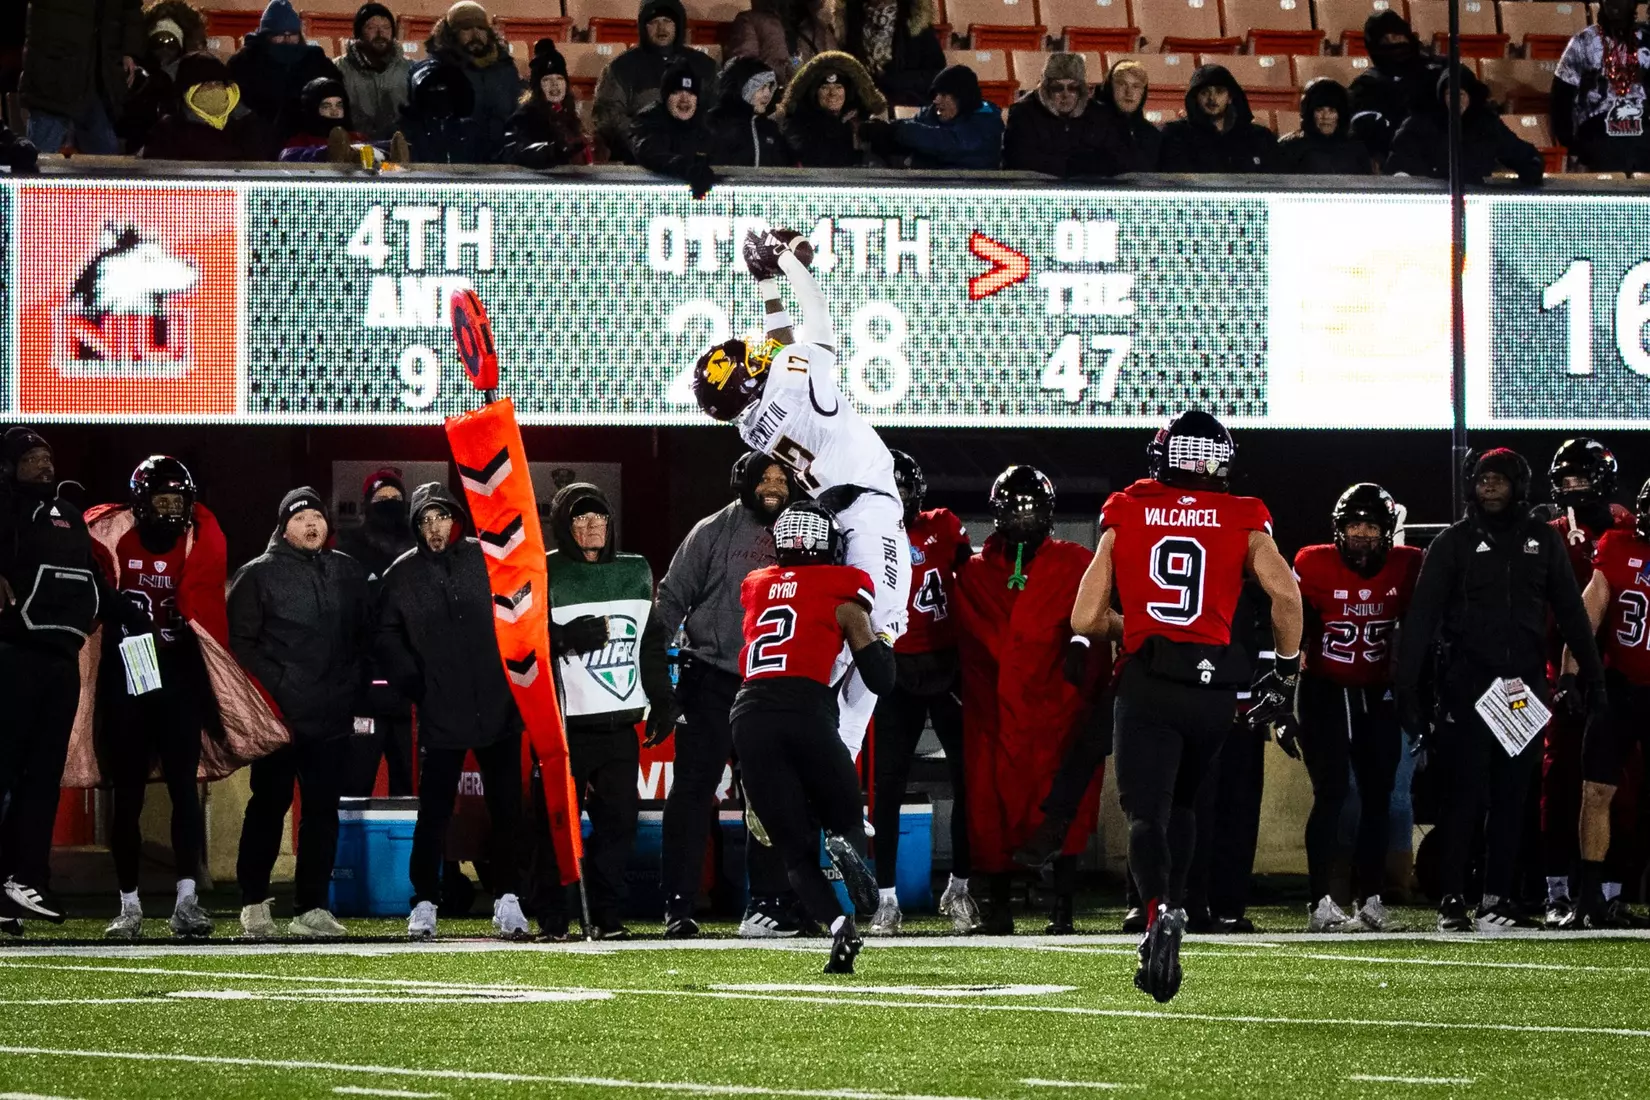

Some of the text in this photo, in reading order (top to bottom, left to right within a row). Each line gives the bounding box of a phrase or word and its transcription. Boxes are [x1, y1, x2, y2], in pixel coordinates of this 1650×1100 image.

[347, 206, 491, 269] 4TH
[809, 217, 930, 273] 4TH
[400, 344, 438, 407] 9
[787, 355, 809, 374] 17
[1042, 334, 1131, 402] 47
[1145, 507, 1221, 527] VALCARCEL
[882, 536, 898, 590] FIRE UP!
[1147, 536, 1206, 626] 9
[768, 582, 797, 600] BYRD
[1343, 603, 1384, 616] NIU
[746, 605, 797, 678] 2
[1322, 620, 1398, 664] 25
